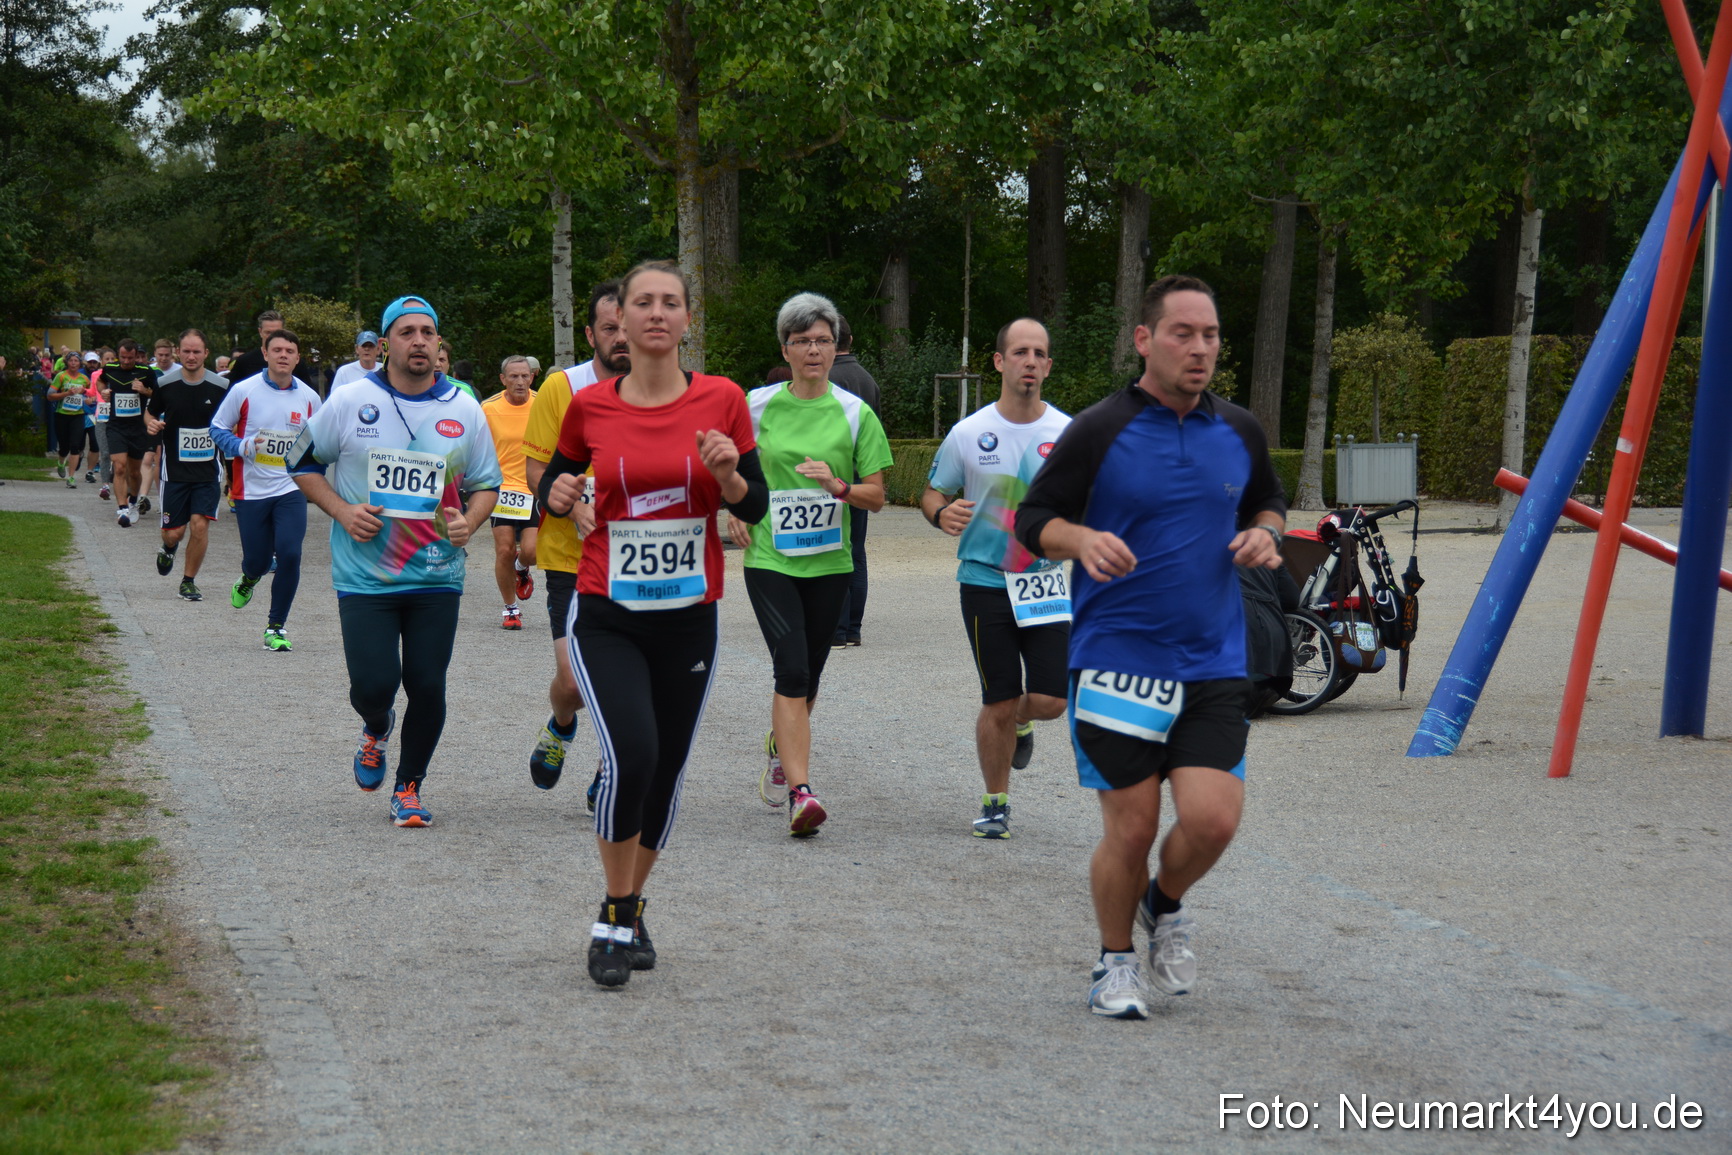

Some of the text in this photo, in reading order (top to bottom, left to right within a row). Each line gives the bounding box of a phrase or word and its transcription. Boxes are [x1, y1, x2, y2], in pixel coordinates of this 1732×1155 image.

[117, 399, 139, 408] 2788
[440, 423, 461, 434] Hervis
[183, 436, 213, 449] 2025
[370, 453, 434, 467] PARTL Neumarkt
[375, 464, 438, 495] 3064
[500, 491, 526, 507] 333
[646, 494, 671, 507] DEHN
[771, 494, 830, 504] PARTL Neumarkt
[500, 507, 522, 515] Günther
[778, 502, 837, 530] 2327
[611, 529, 690, 538] PARTL Neumarkt
[796, 534, 823, 547] Ingrid
[425, 546, 443, 557] 16.
[620, 540, 696, 576] 2594
[637, 584, 681, 599] Regina
[1015, 573, 1066, 601] 2328
[1029, 602, 1066, 616] Matthias
[1090, 669, 1178, 706] 2009
